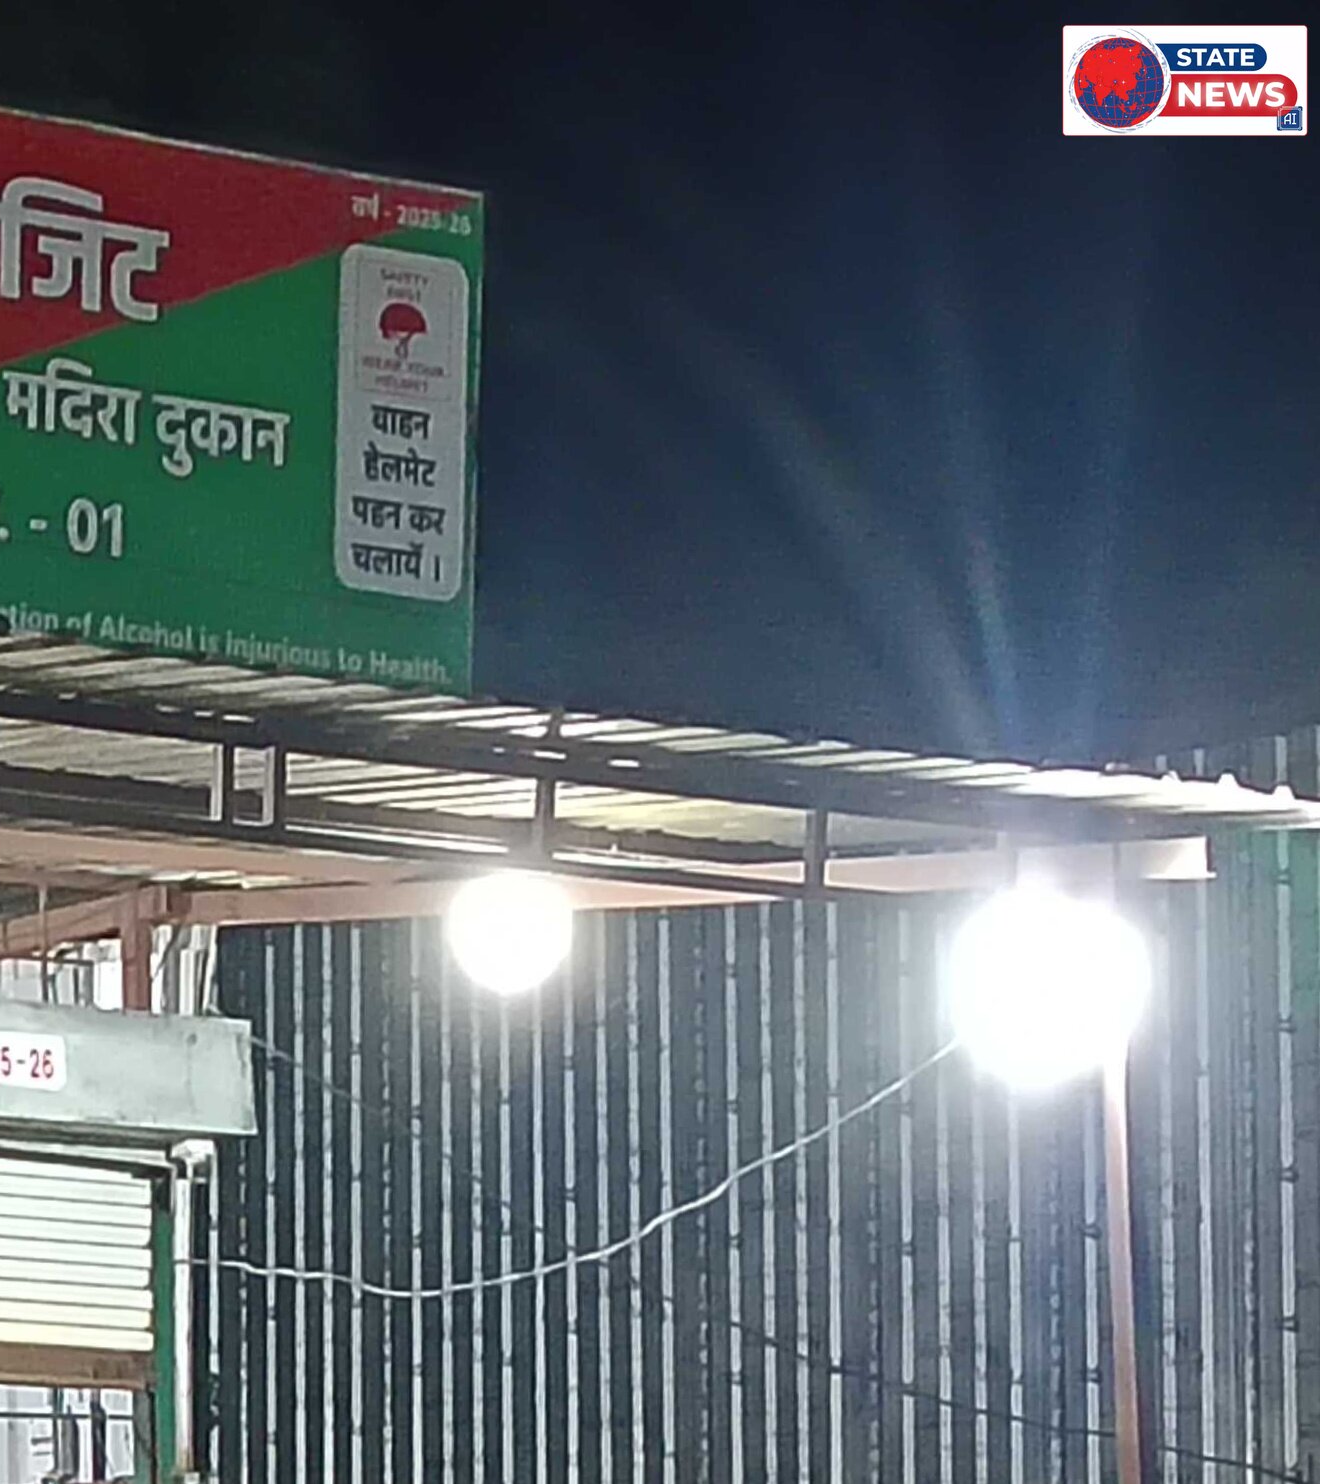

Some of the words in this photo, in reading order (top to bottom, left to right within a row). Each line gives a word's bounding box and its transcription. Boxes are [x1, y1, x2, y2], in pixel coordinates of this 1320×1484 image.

[2, 357, 142, 445] मदिरा
[152, 394, 291, 477] दुकान
[371, 404, 430, 439] वाहन
[363, 441, 437, 487] हेलमेट
[66, 498, 127, 558] 01
[352, 495, 404, 529] पहन
[408, 504, 446, 535] कर
[100, 614, 194, 650] Alcohol
[199, 624, 219, 652] is
[338, 647, 361, 673] to
